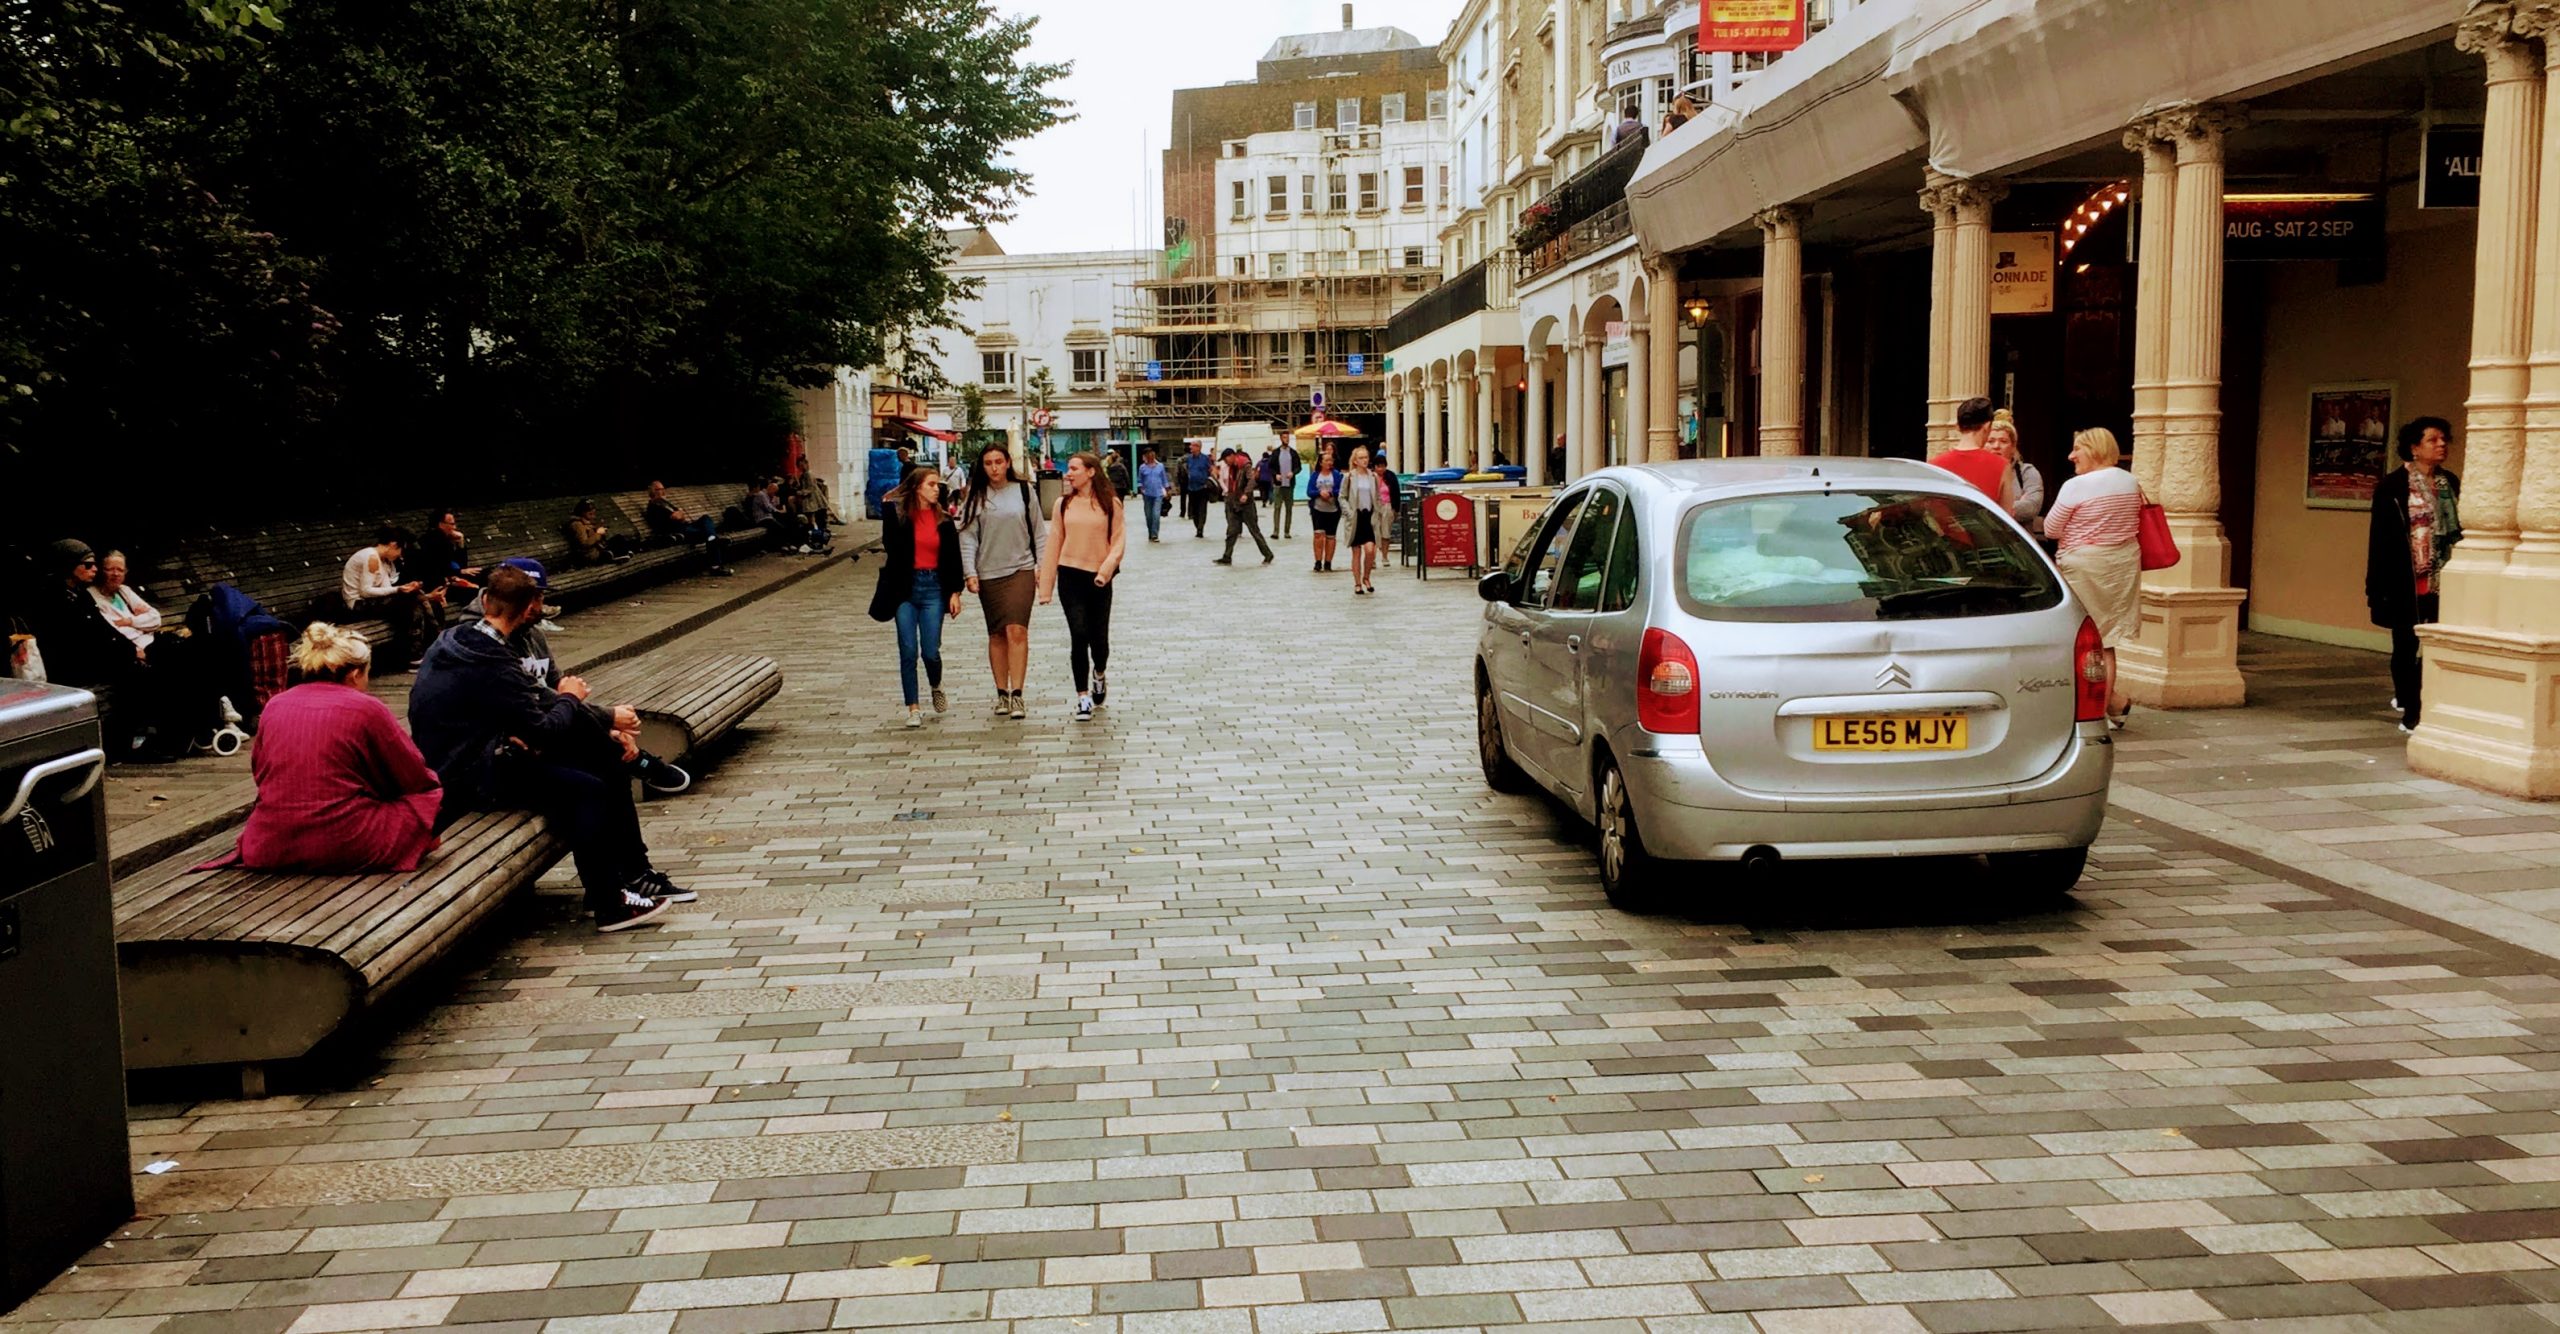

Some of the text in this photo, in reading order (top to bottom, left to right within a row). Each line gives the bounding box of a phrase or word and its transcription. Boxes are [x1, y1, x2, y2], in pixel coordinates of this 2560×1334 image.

[1744, 27, 1760, 37] SAT
[1772, 26, 1790, 37] AUG
[1611, 60, 1631, 79] BAR
[2226, 222, 2262, 238] AUG
[2274, 221, 2305, 238] SAT
[2307, 221, 2319, 237] 2
[2322, 220, 2354, 237] SEP
[1991, 270, 2047, 283] ONNADE
[1825, 719, 1957, 745] LE56 MJY
